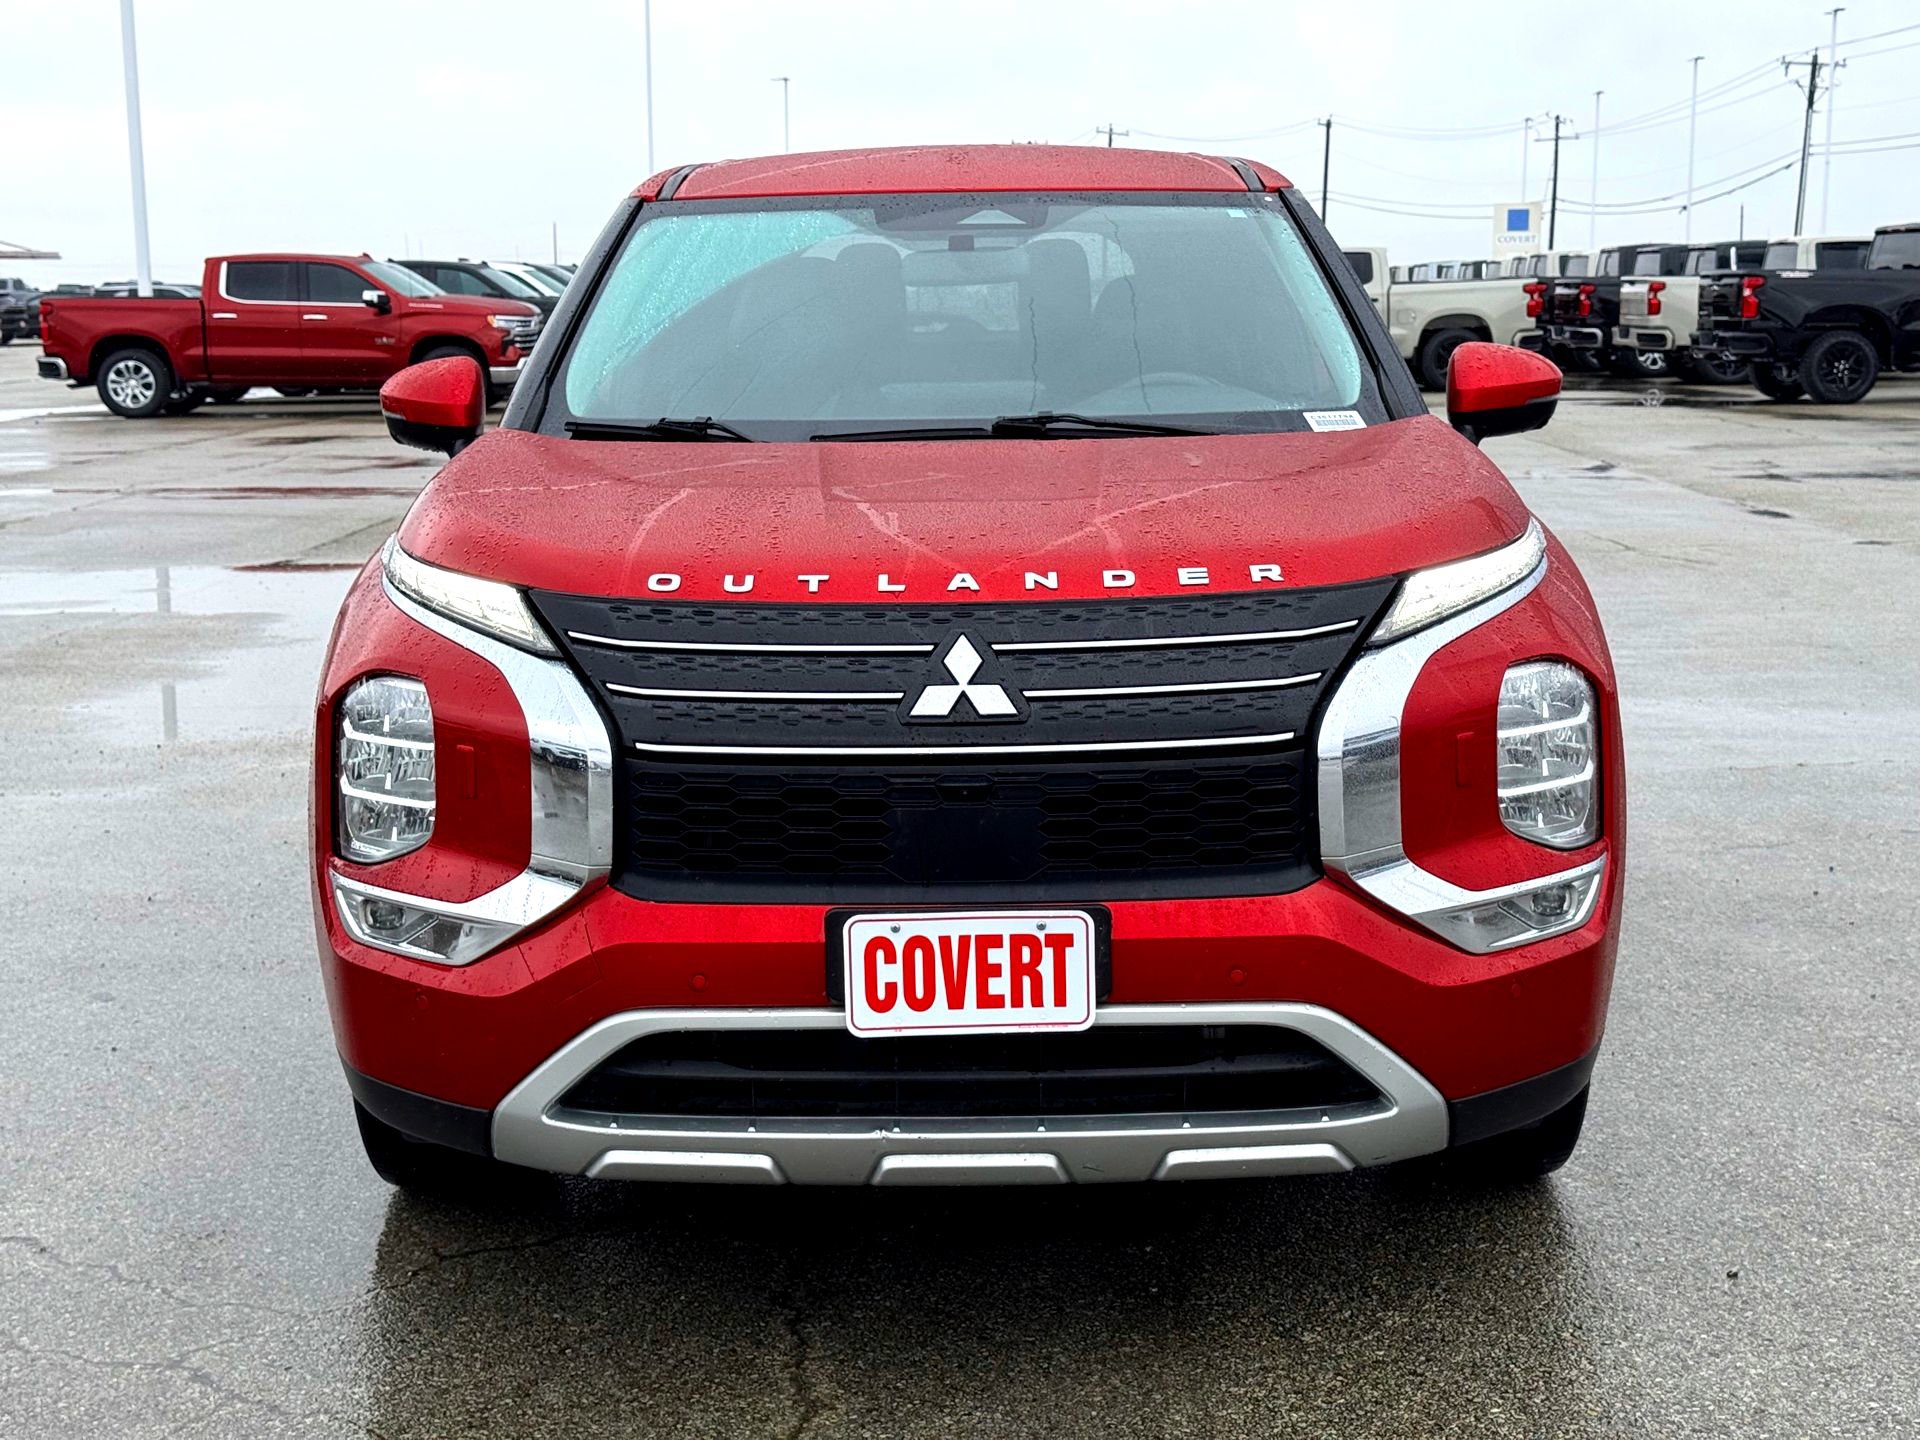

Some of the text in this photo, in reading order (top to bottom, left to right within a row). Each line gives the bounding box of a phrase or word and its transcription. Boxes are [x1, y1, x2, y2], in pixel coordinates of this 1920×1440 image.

[1497, 234, 1536, 243] COVERT
[647, 564, 1284, 592] OUTLANDER
[864, 933, 1074, 1013] COVERT
